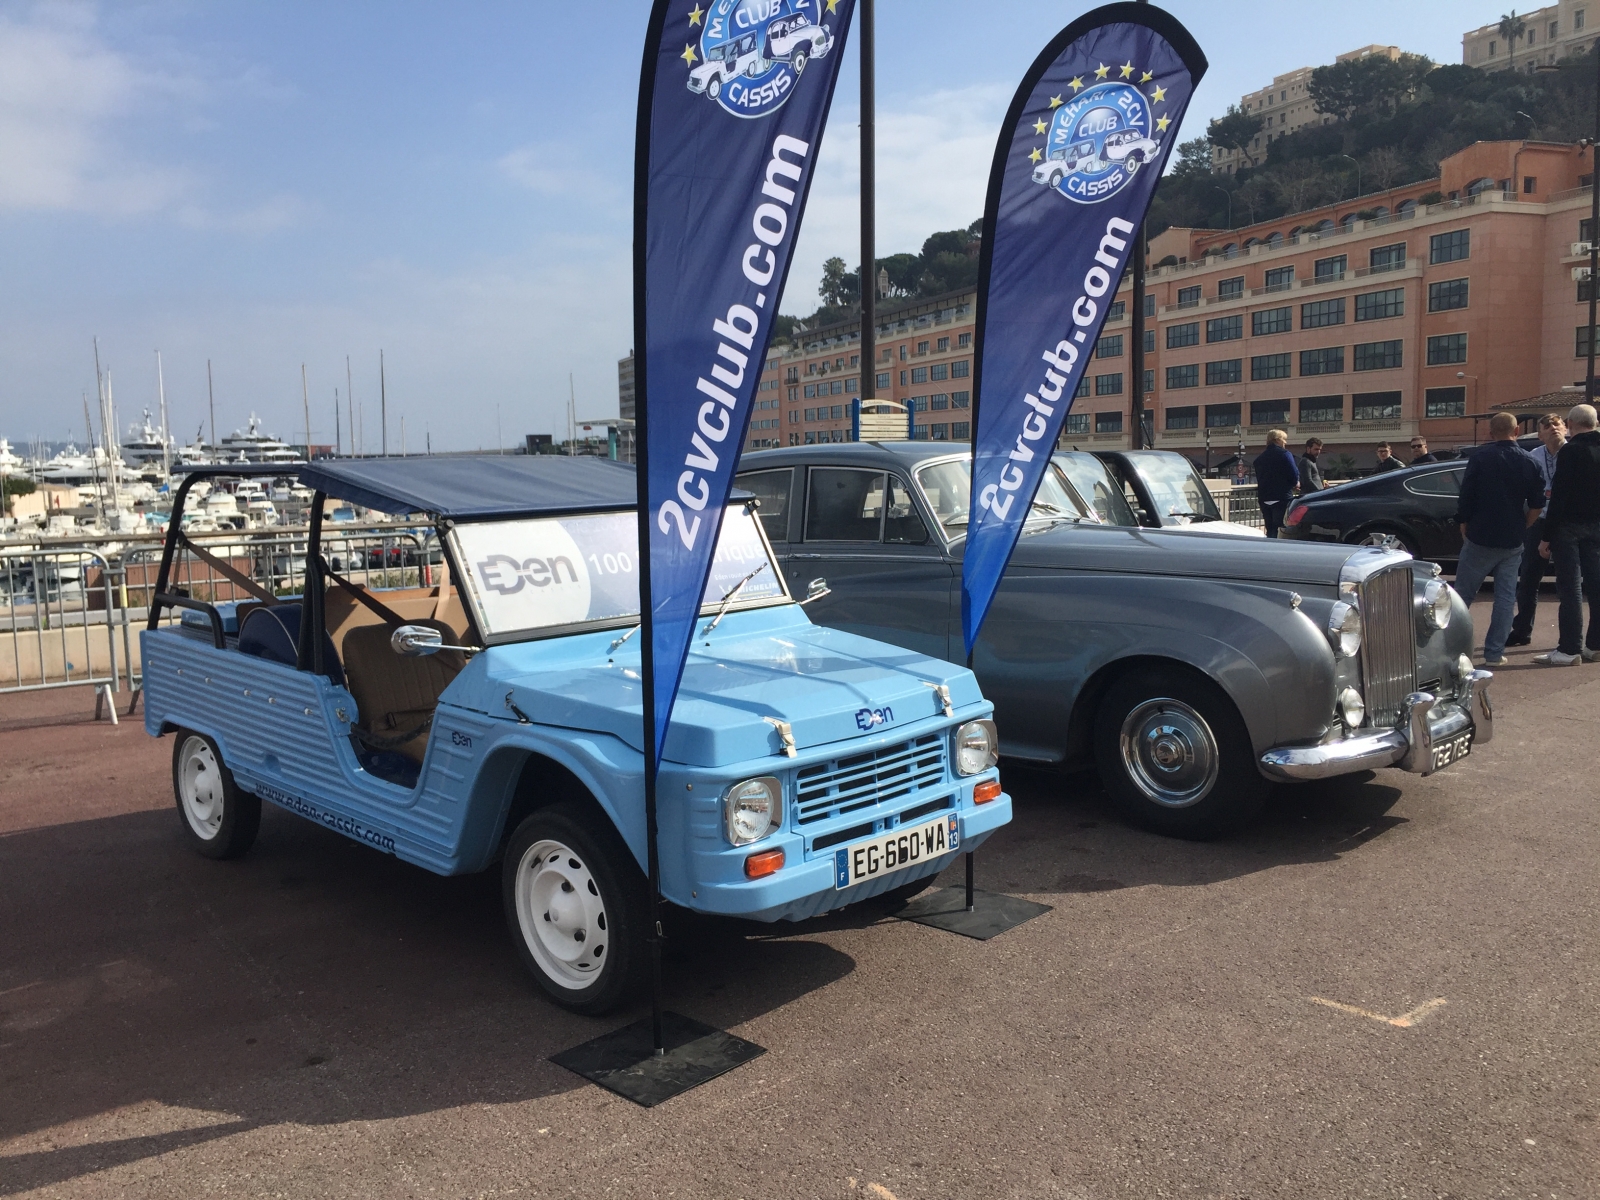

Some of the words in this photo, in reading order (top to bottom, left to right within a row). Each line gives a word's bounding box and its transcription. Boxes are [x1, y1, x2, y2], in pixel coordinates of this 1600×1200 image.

[735, 0, 781, 29] CLUB
[728, 68, 791, 108] CASSIS
[1055, 90, 1109, 144] MEHARI
[1117, 91, 1144, 127] 2CV
[1078, 116, 1118, 137] CLUB
[1067, 169, 1124, 196] CASSIS
[657, 133, 810, 552] 2cvclub.com
[979, 216, 1135, 521] 2cvclub.com
[589, 551, 632, 575] 100
[1432, 743, 1451, 770] 762
[255, 782, 397, 852] www.eden-cassis.com
[854, 823, 945, 879] EG-660-WA
[949, 832, 958, 846] 13
[840, 872, 845, 881] F
